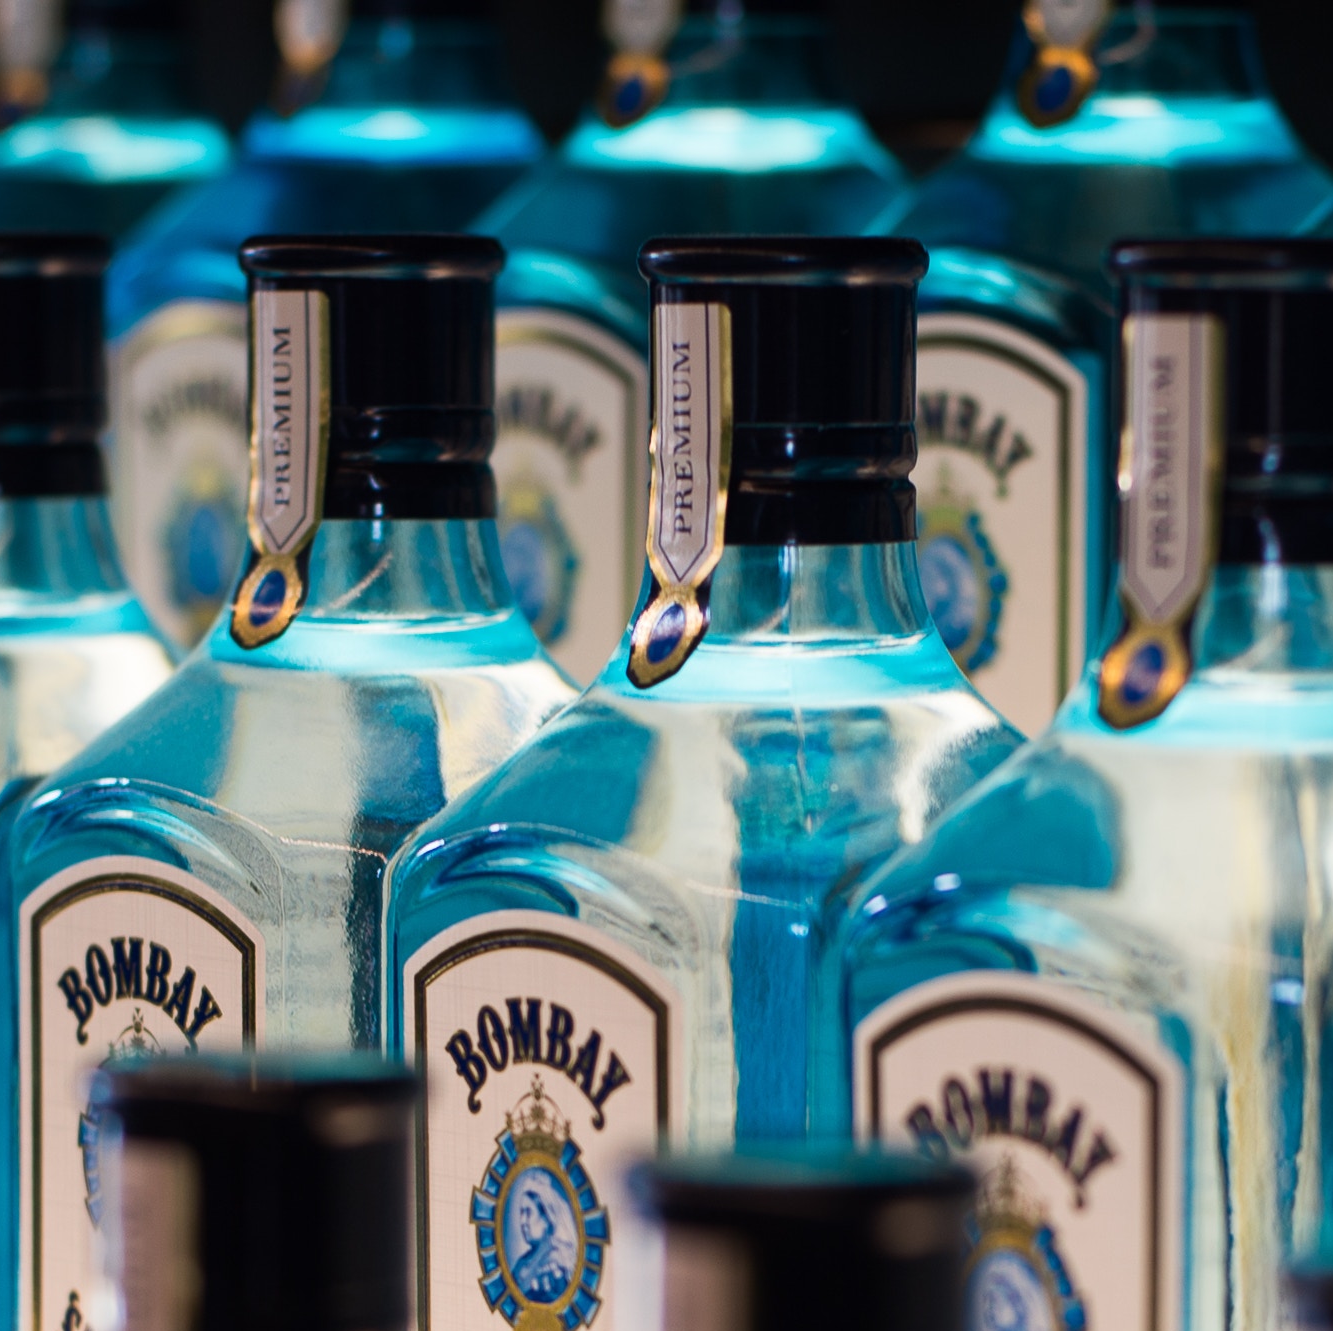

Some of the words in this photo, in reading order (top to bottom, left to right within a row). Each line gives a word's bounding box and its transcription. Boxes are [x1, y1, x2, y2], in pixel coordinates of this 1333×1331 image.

[273, 326, 292, 507] PREMIUM
[672, 340, 693, 535] PREMIUM
[917, 388, 1033, 498] MBAY
[57, 936, 223, 1053] BOMBAY
[445, 998, 632, 1131] BOMBAY
